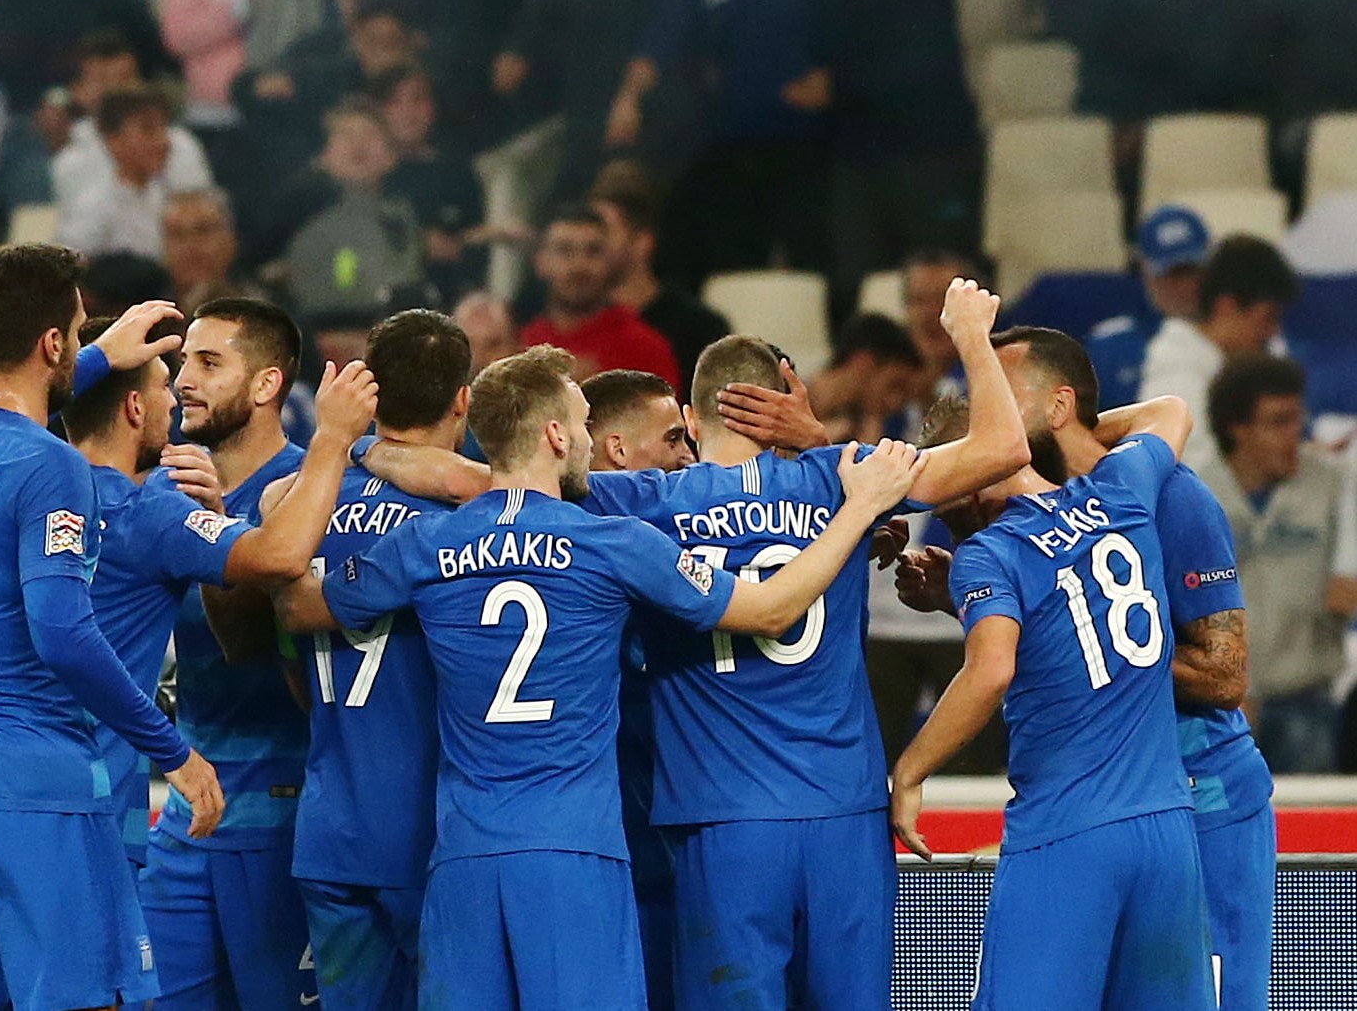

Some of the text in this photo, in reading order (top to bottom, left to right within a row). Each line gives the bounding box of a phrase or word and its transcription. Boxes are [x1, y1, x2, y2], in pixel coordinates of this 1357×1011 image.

[674, 500, 831, 541] FORTOUNIS
[438, 532, 574, 578] BAKAKIS
[1200, 569, 1236, 583] RESPECT
[1055, 532, 1164, 690] 18
[480, 579, 556, 724] 2
